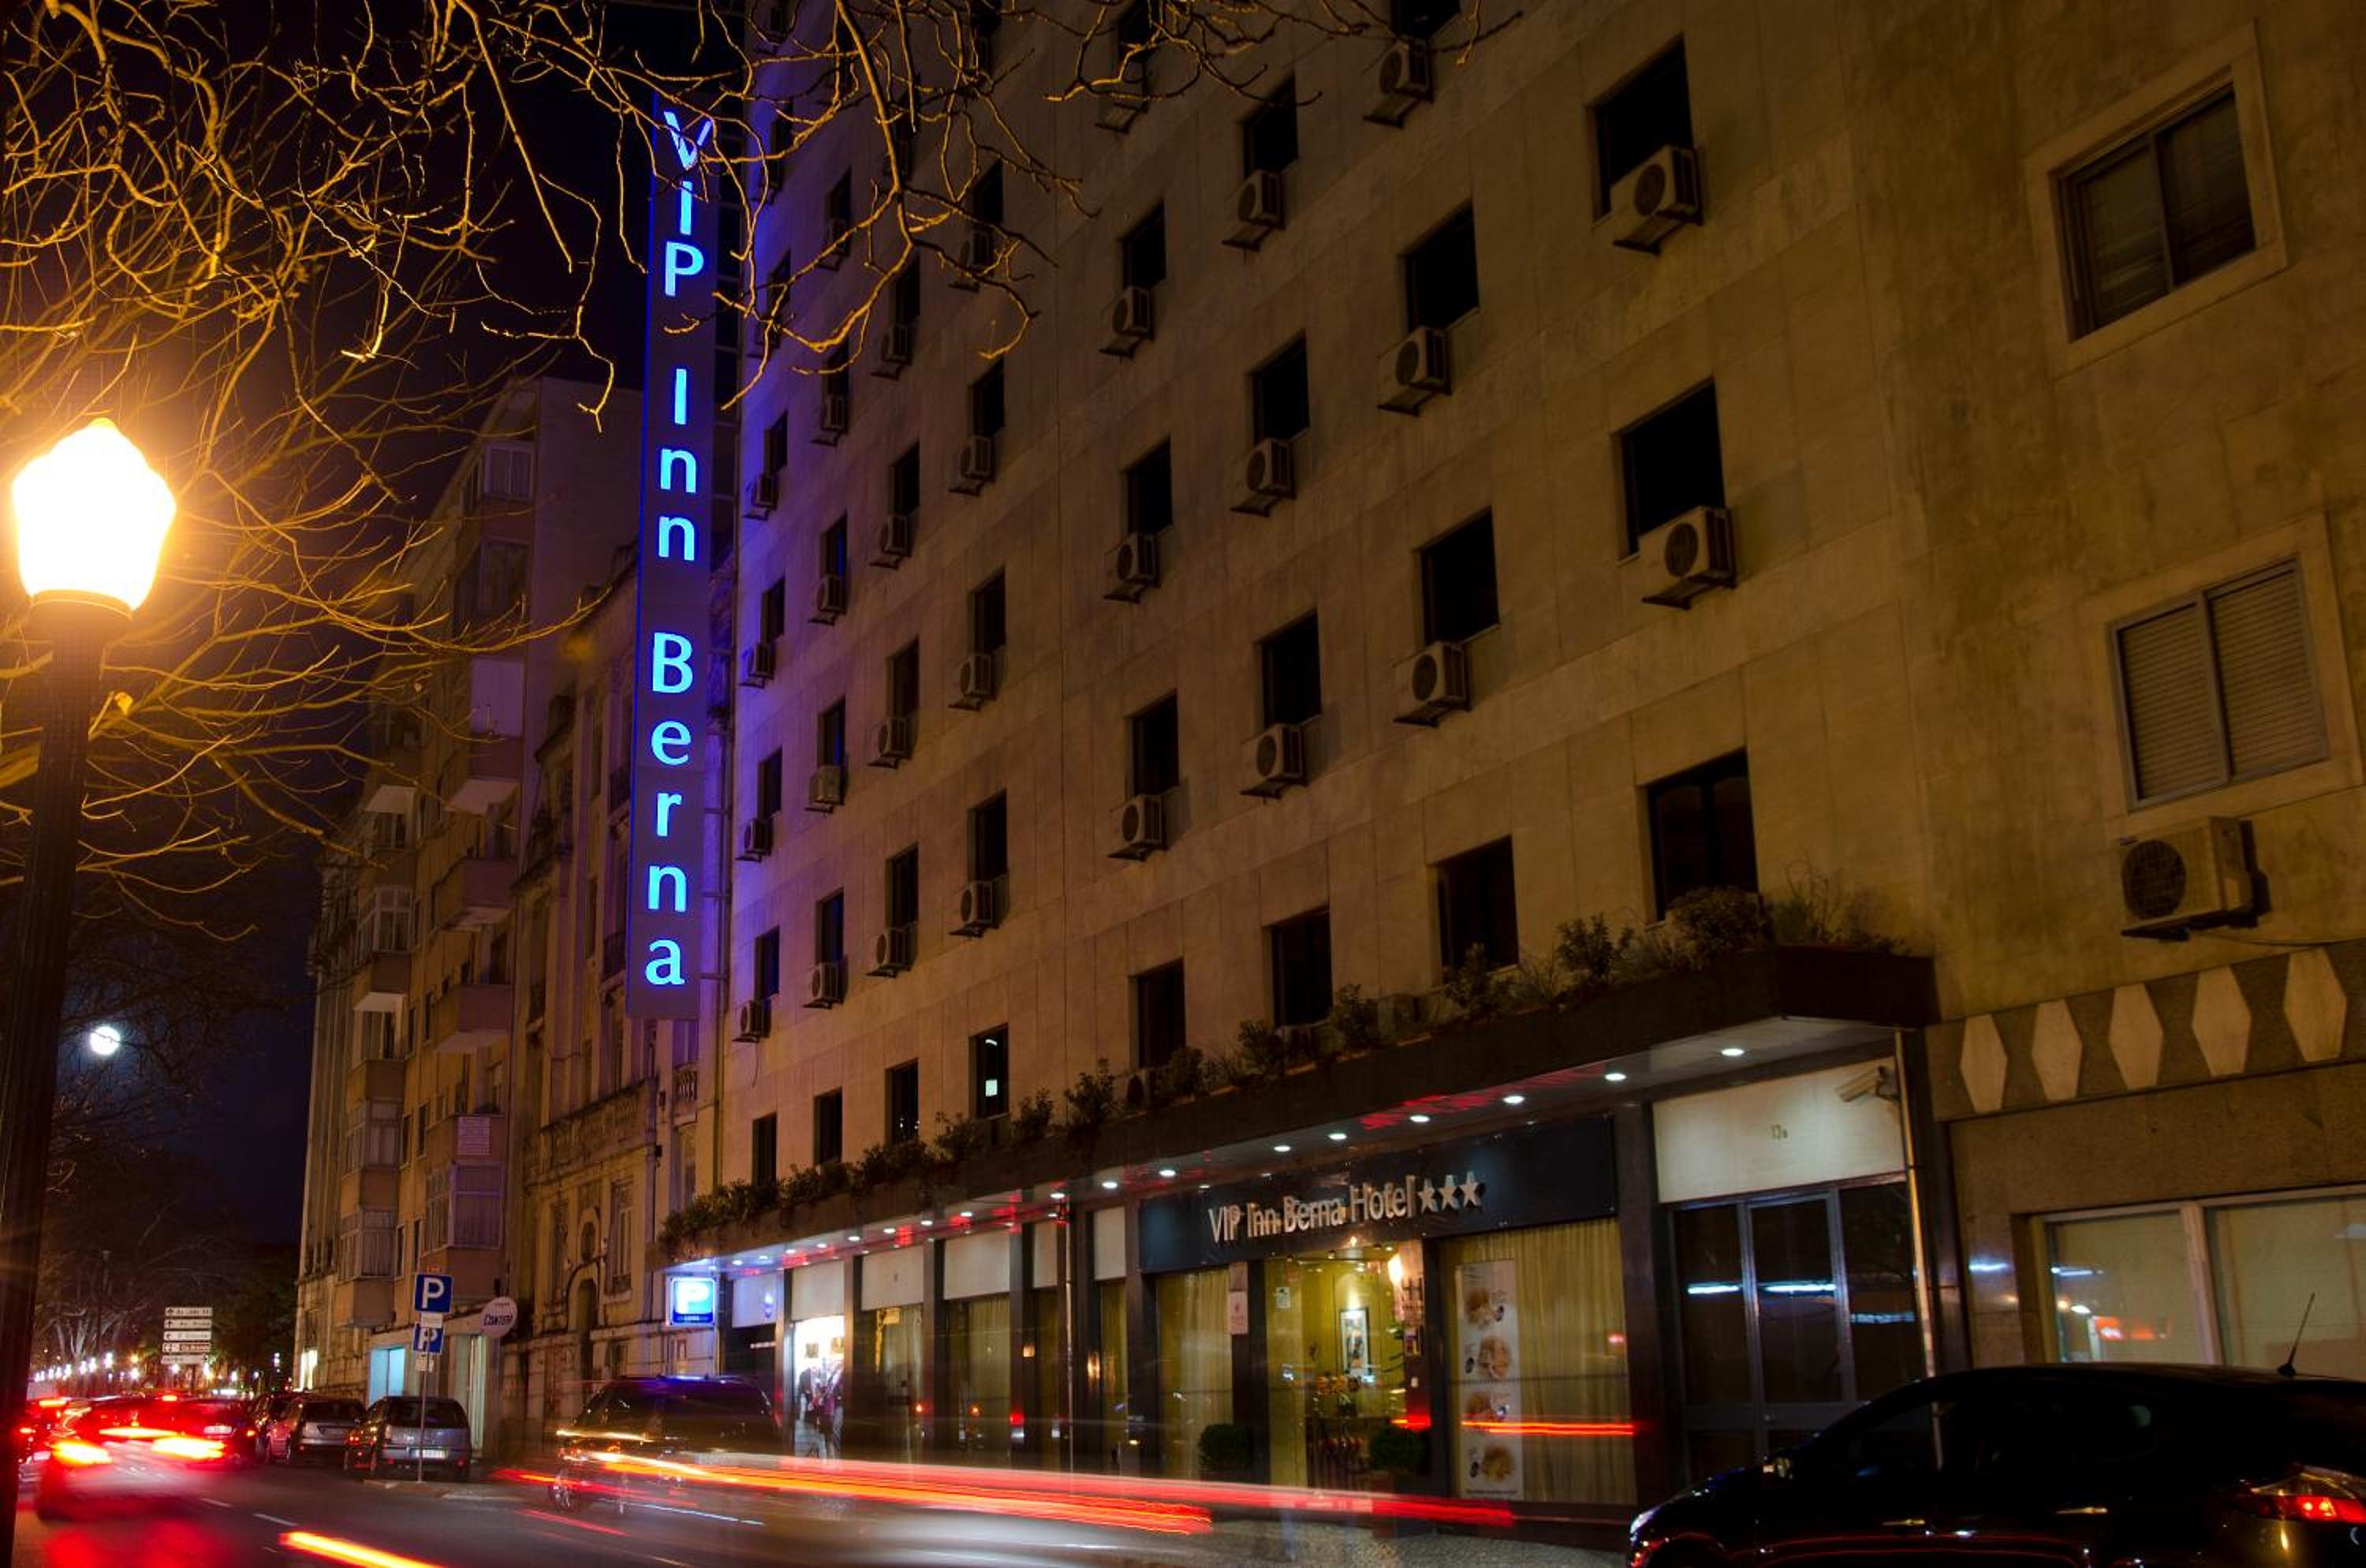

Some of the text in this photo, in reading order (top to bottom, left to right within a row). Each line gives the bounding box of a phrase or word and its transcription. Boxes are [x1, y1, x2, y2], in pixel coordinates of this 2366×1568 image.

[644, 110, 713, 986] VIP Inn Berna
[1207, 1174, 1416, 1244] VIP Inn Berna Hotel
[421, 1277, 445, 1309] P
[676, 1279, 709, 1315] P
[418, 1327, 438, 1350] P
